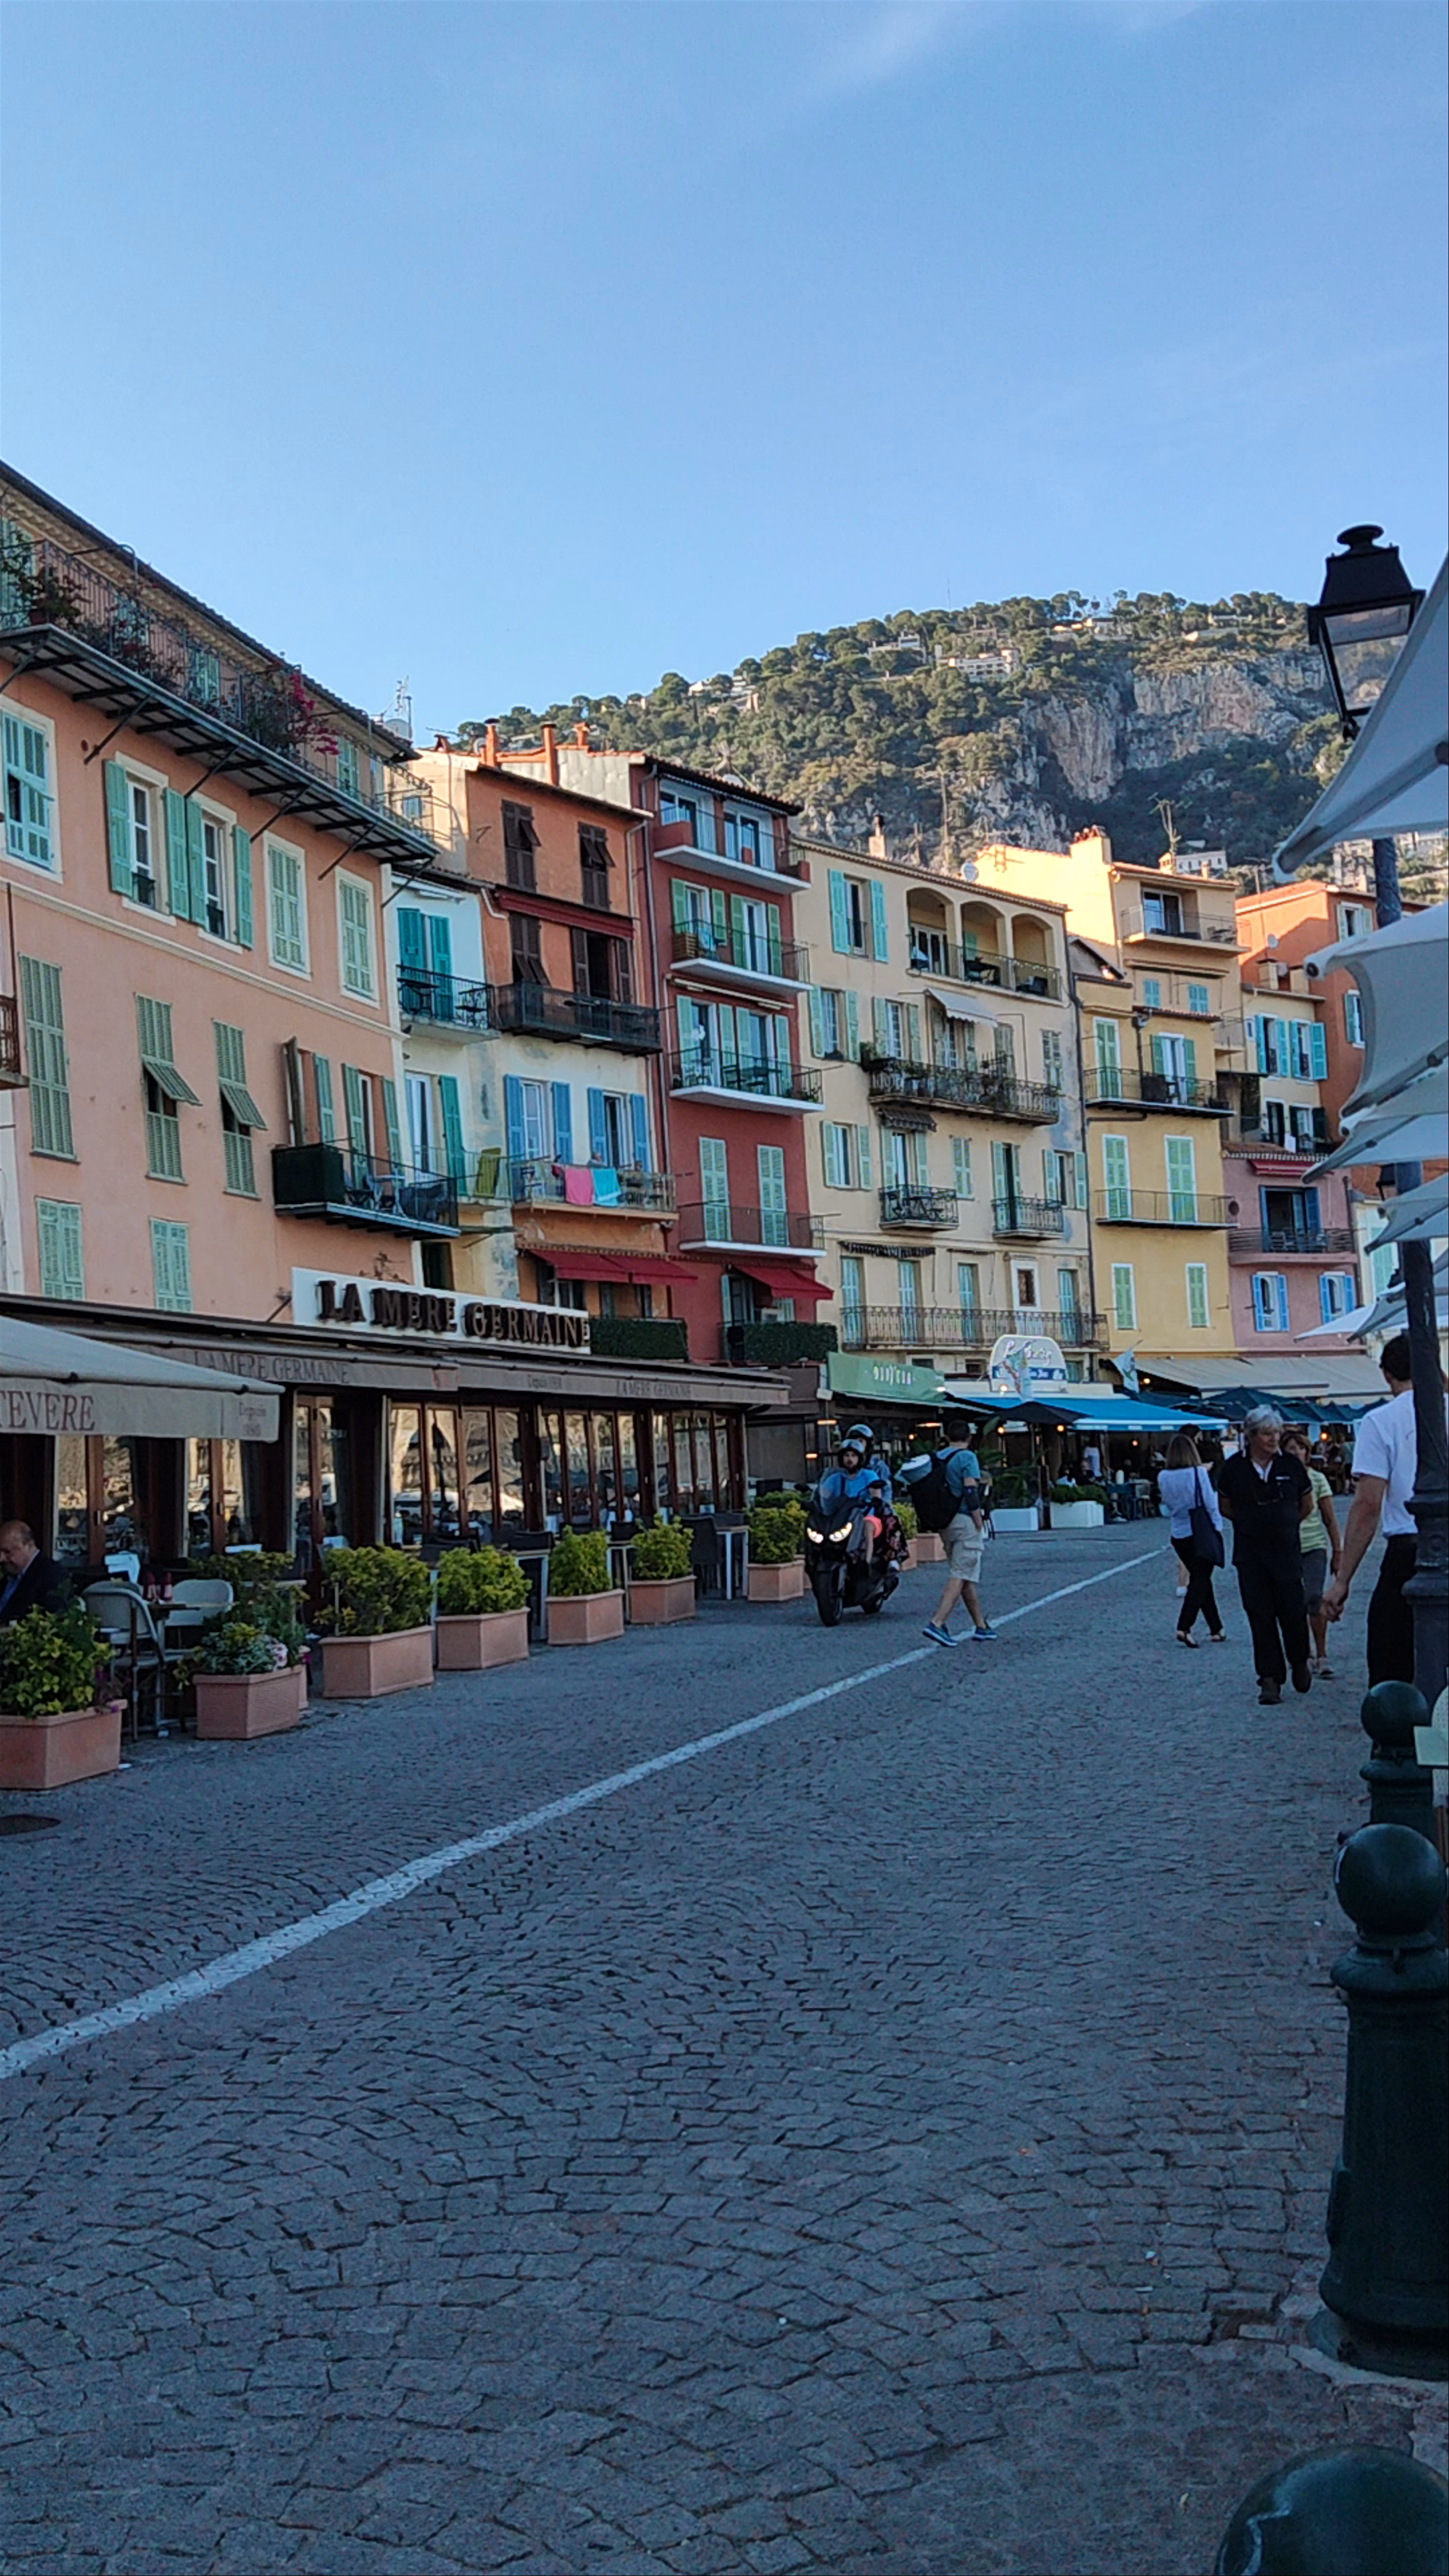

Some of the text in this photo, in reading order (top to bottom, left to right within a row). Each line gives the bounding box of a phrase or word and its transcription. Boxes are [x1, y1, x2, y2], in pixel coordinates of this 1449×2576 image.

[315, 1280, 590, 1348] LA MERE GERMAINE
[226, 1353, 267, 1380] MERE
[272, 1358, 349, 1383] GERMAINE
[616, 1380, 628, 1395] LA
